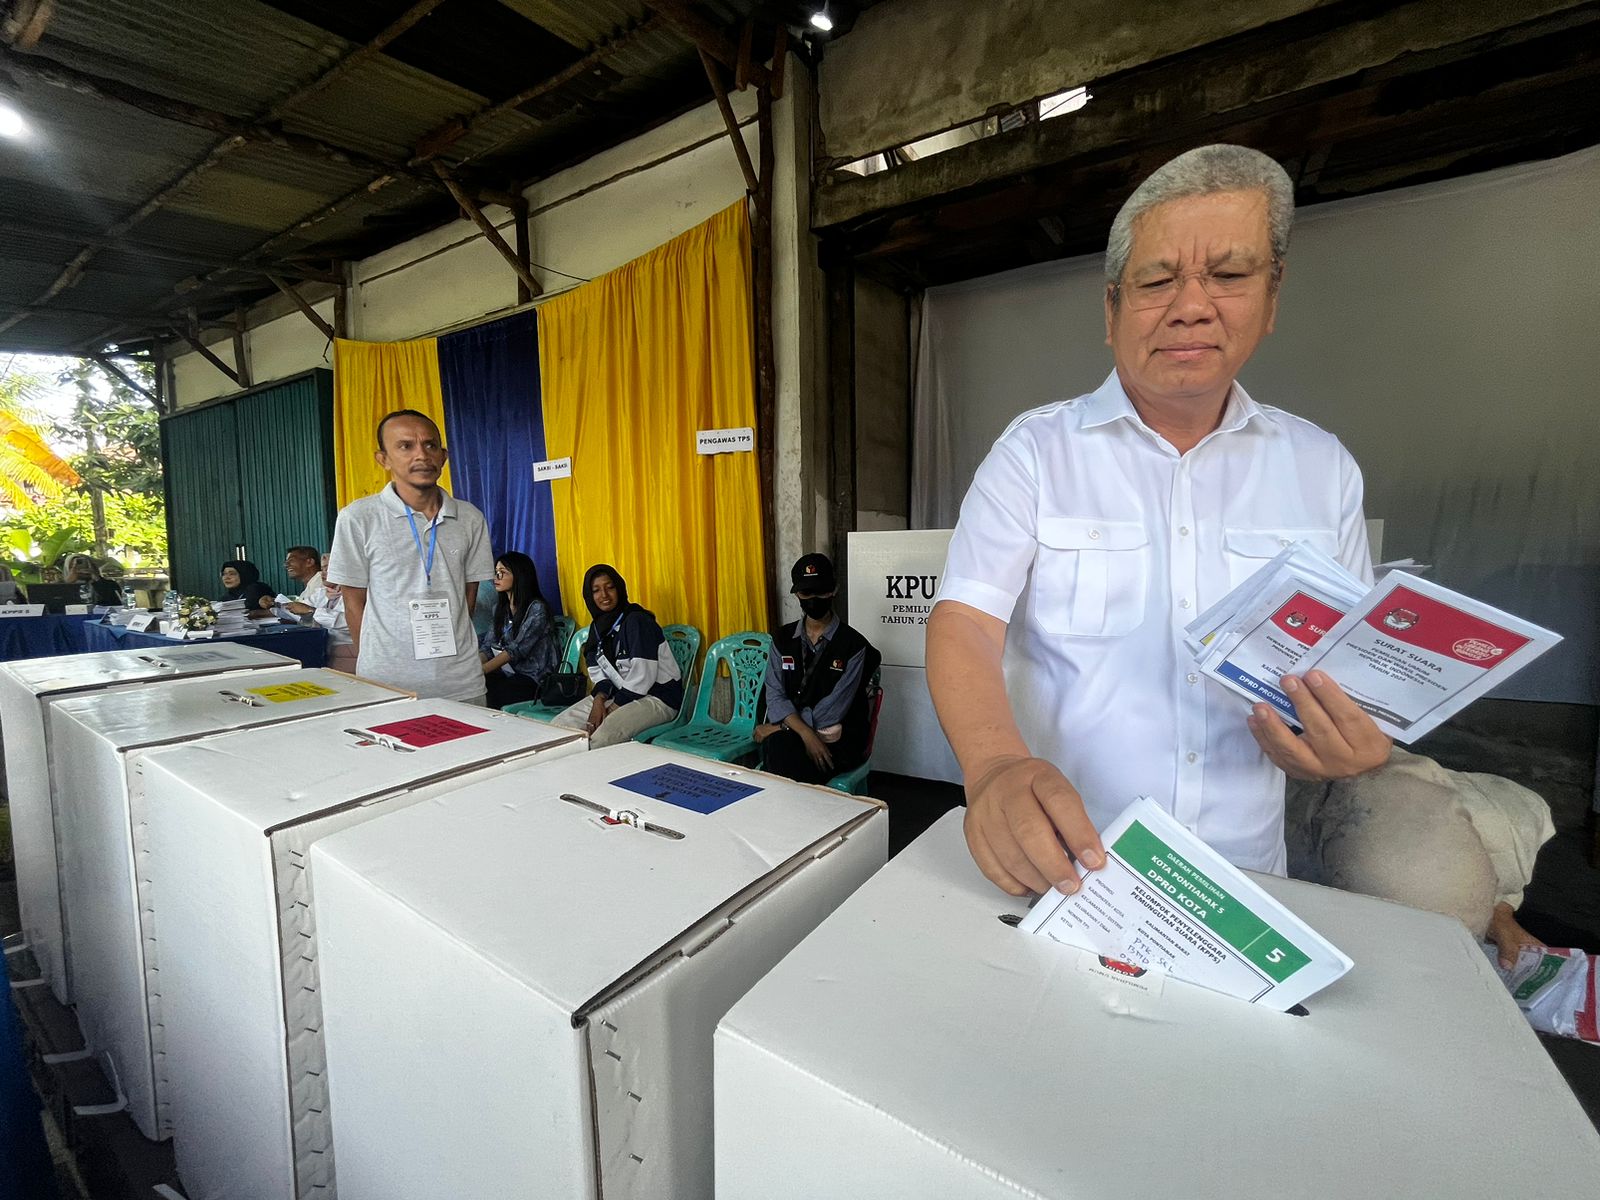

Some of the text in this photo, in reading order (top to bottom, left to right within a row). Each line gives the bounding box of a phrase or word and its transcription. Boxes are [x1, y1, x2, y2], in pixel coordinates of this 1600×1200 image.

[886, 575, 937, 600] KPU
[881, 615, 914, 624] TAHUN
[892, 605, 931, 613] PEMILU
[1346, 641, 1376, 657] PRESIDEN
[1393, 663, 1414, 673] WAKIL
[1414, 673, 1448, 690] PRESIDEN
[1358, 652, 1424, 684] REPUBLIK INDONESIA
[1371, 647, 1406, 664] PEMILIHAN
[1374, 638, 1443, 672] SURAT SUARA
[1368, 663, 1406, 681] TAHUN 2024
[1238, 675, 1259, 688] DPRD
[1258, 686, 1291, 707] PROVINSI
[1150, 854, 1225, 914] KOTA PONTIANAK 5
[1166, 852, 1225, 900] DAERAH PEMILIHAN
[1146, 868, 1208, 919] DPRD KOTA
[1130, 890, 1221, 965] PEMUNGUTAN SUARA (KPPS)
[1134, 885, 1227, 961] KELOMPOK PENYELENGGARA
[1144, 920, 1190, 956] KALIMANTAN BARAT
[1136, 927, 1176, 959] KOTA PONTIANAK
[1264, 947, 1286, 964] 5
